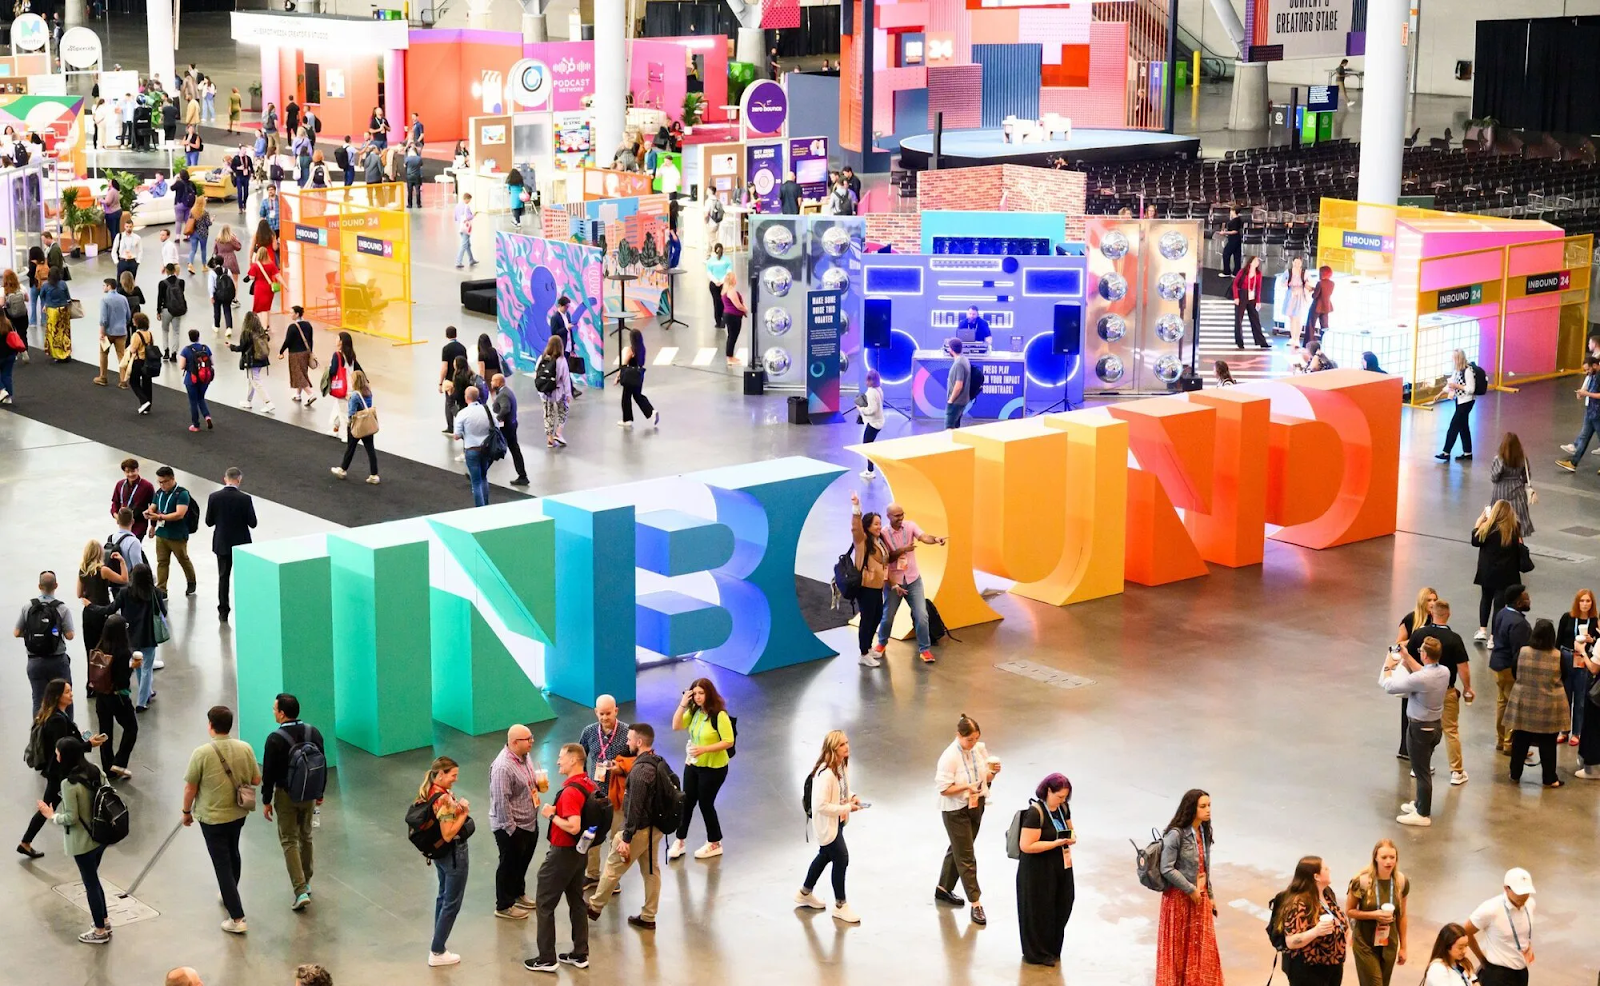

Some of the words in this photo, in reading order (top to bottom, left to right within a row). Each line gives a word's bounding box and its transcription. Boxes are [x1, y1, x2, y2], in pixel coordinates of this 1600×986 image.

[1276, 12, 1313, 33] CREATORS
[1316, 11, 1338, 31] STAGE
[553, 79, 590, 87] PODCAST
[368, 217, 379, 226] 24
[296, 228, 319, 240] INBOUND
[358, 239, 383, 251] INBOUND
[383, 245, 393, 255] 24
[1345, 235, 1381, 247] INBOUND
[1383, 240, 1395, 250] 24
[1527, 277, 1558, 289] INBOUND
[1560, 276, 1570, 286] 24
[811, 297, 824, 305] MAKE
[1439, 291, 1470, 304] INBOUND
[1471, 290, 1481, 299] 24
[825, 305, 836, 313] THIS
[814, 315, 834, 324] QUARTER
[983, 364, 998, 375] PRESS
[998, 365, 1010, 374] PLAY
[990, 375, 1003, 385] YOUR
[1003, 375, 1021, 385] IMPACT
[982, 384, 1014, 394] SOUNDTRACK!
[233, 370, 1402, 769] INBOUND
